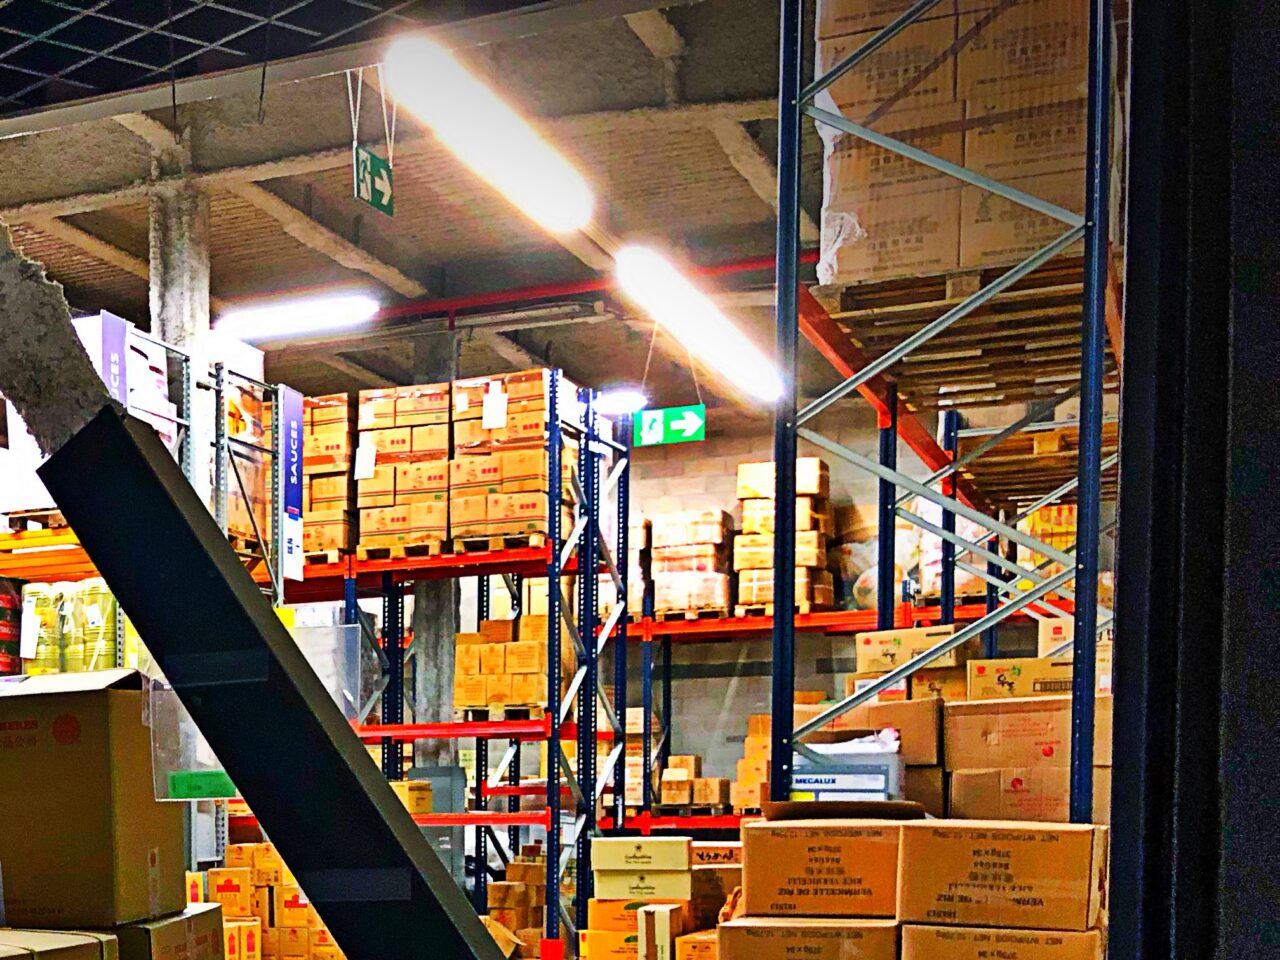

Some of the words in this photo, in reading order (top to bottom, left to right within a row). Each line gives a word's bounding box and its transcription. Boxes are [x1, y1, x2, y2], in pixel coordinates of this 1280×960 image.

[290, 420, 298, 485] SAUCES
[796, 888, 810, 896] DE
[813, 888, 873, 896] VERMICELLE
